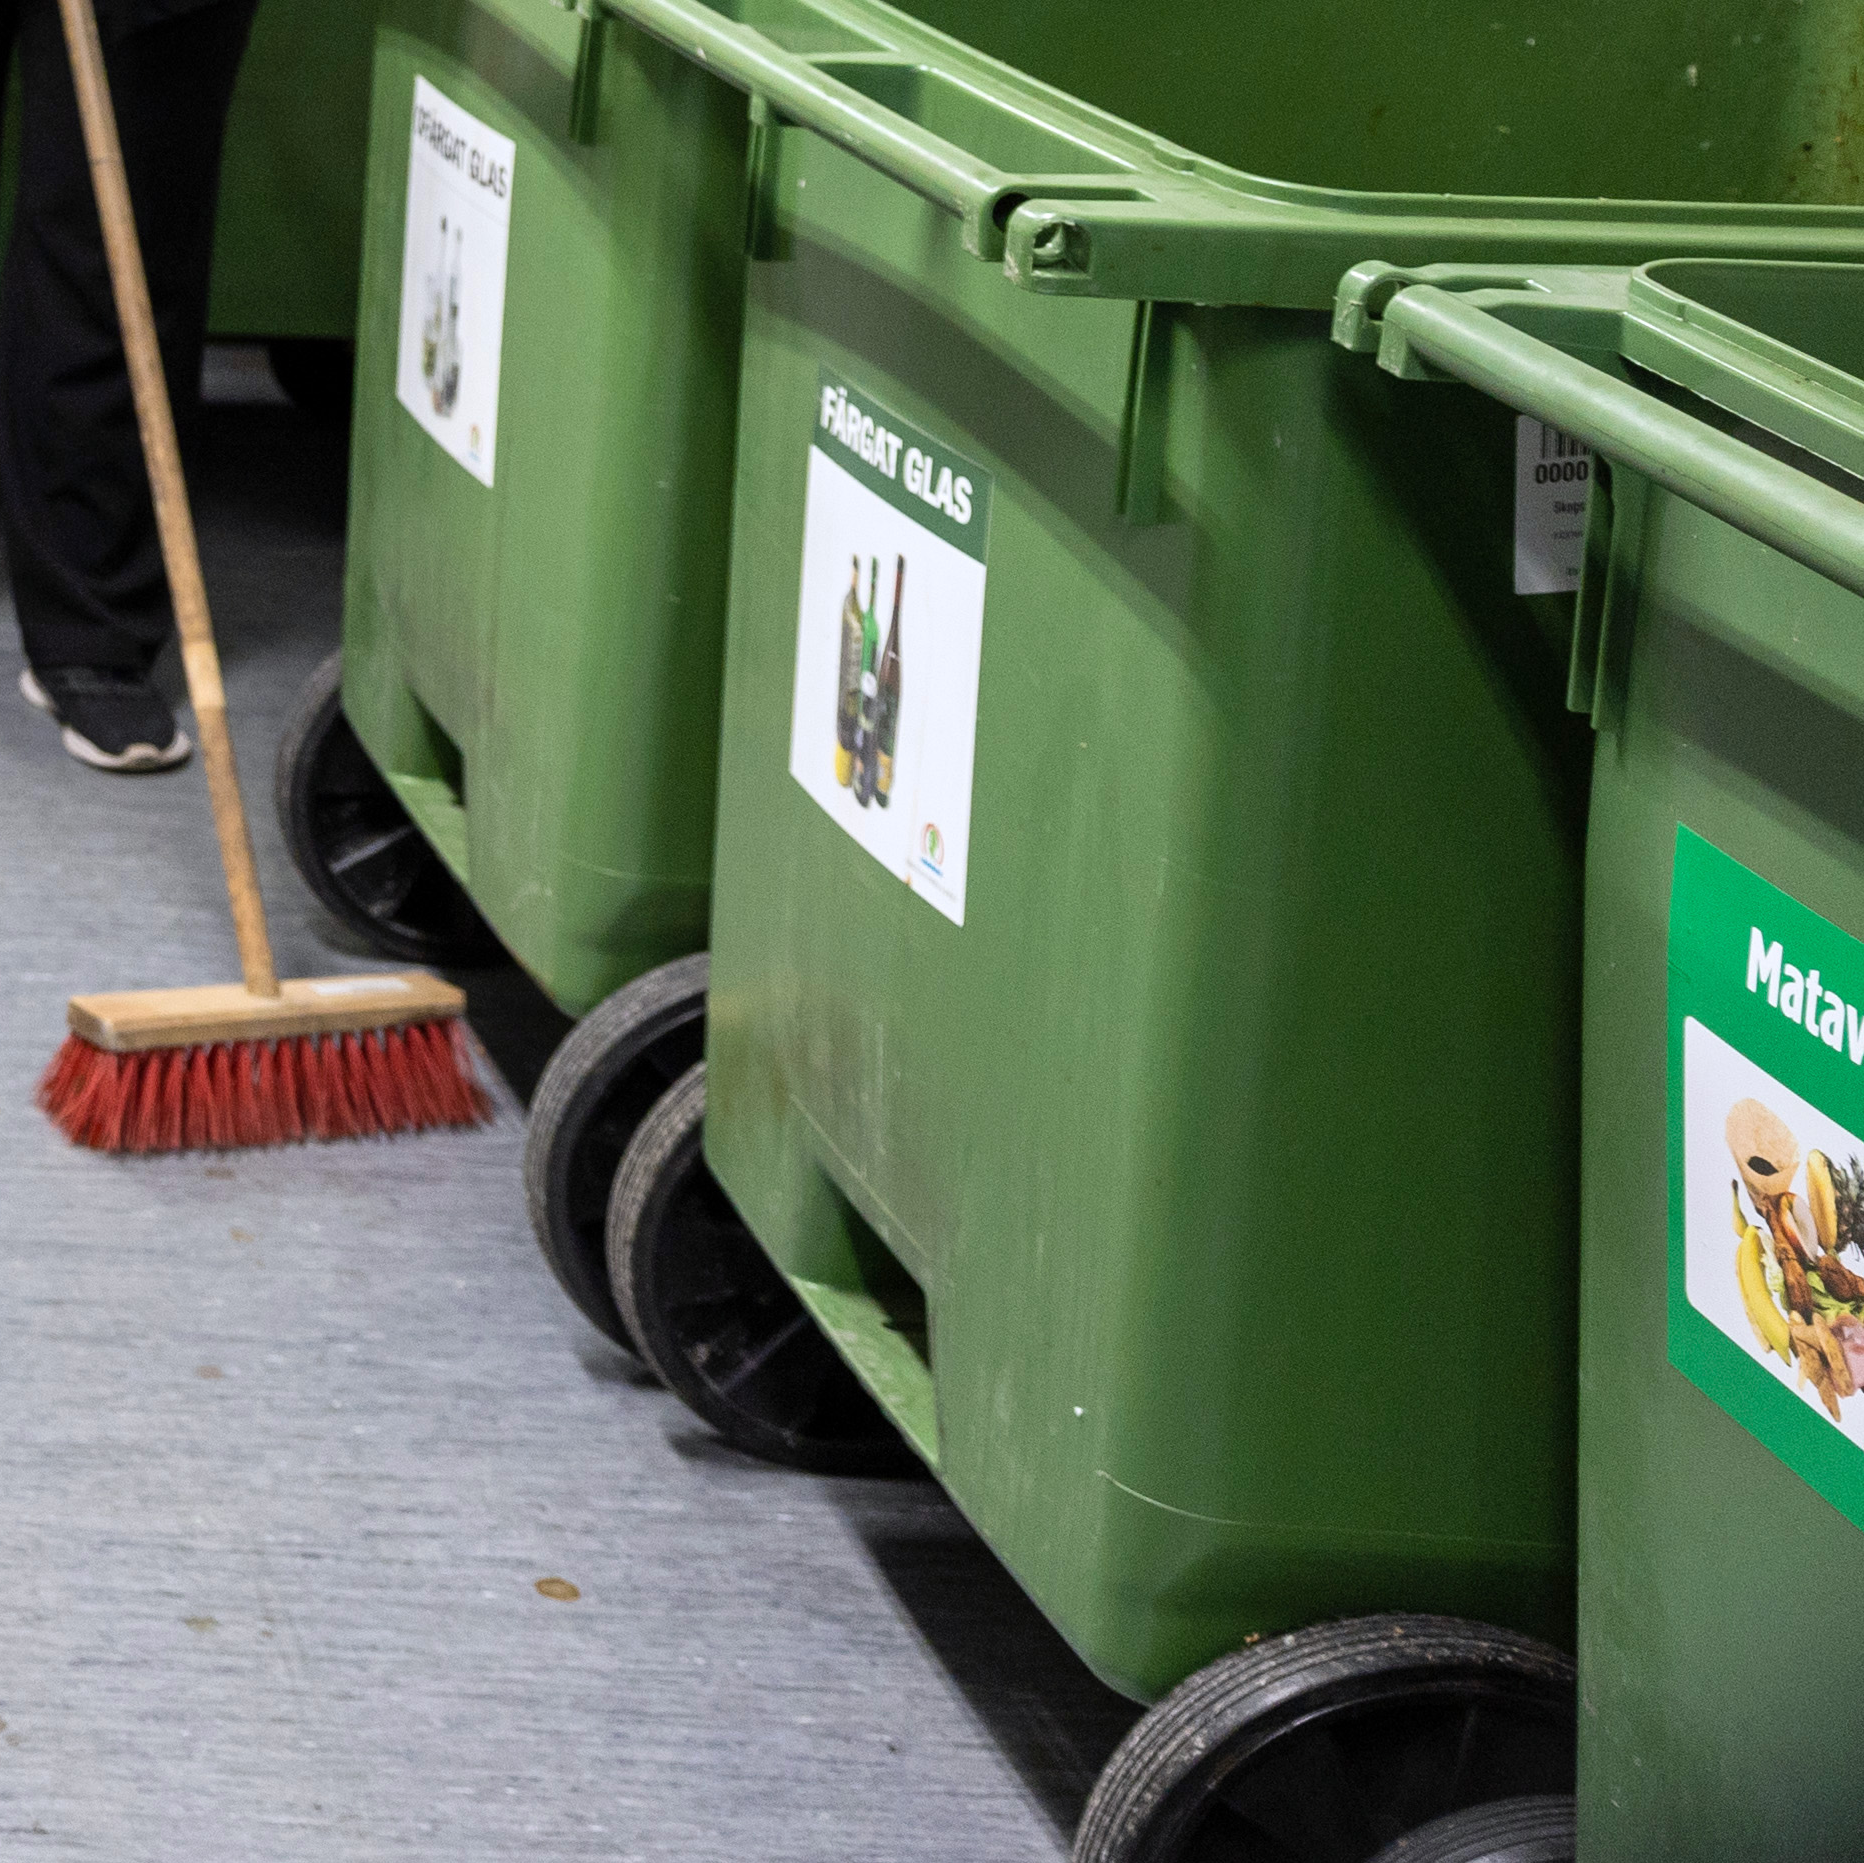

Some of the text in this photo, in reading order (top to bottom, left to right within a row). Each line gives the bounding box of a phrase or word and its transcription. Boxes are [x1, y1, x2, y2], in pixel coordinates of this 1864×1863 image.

[470, 148, 508, 198] GLAS
[820, 385, 974, 525] FÄRGAT GLAS
